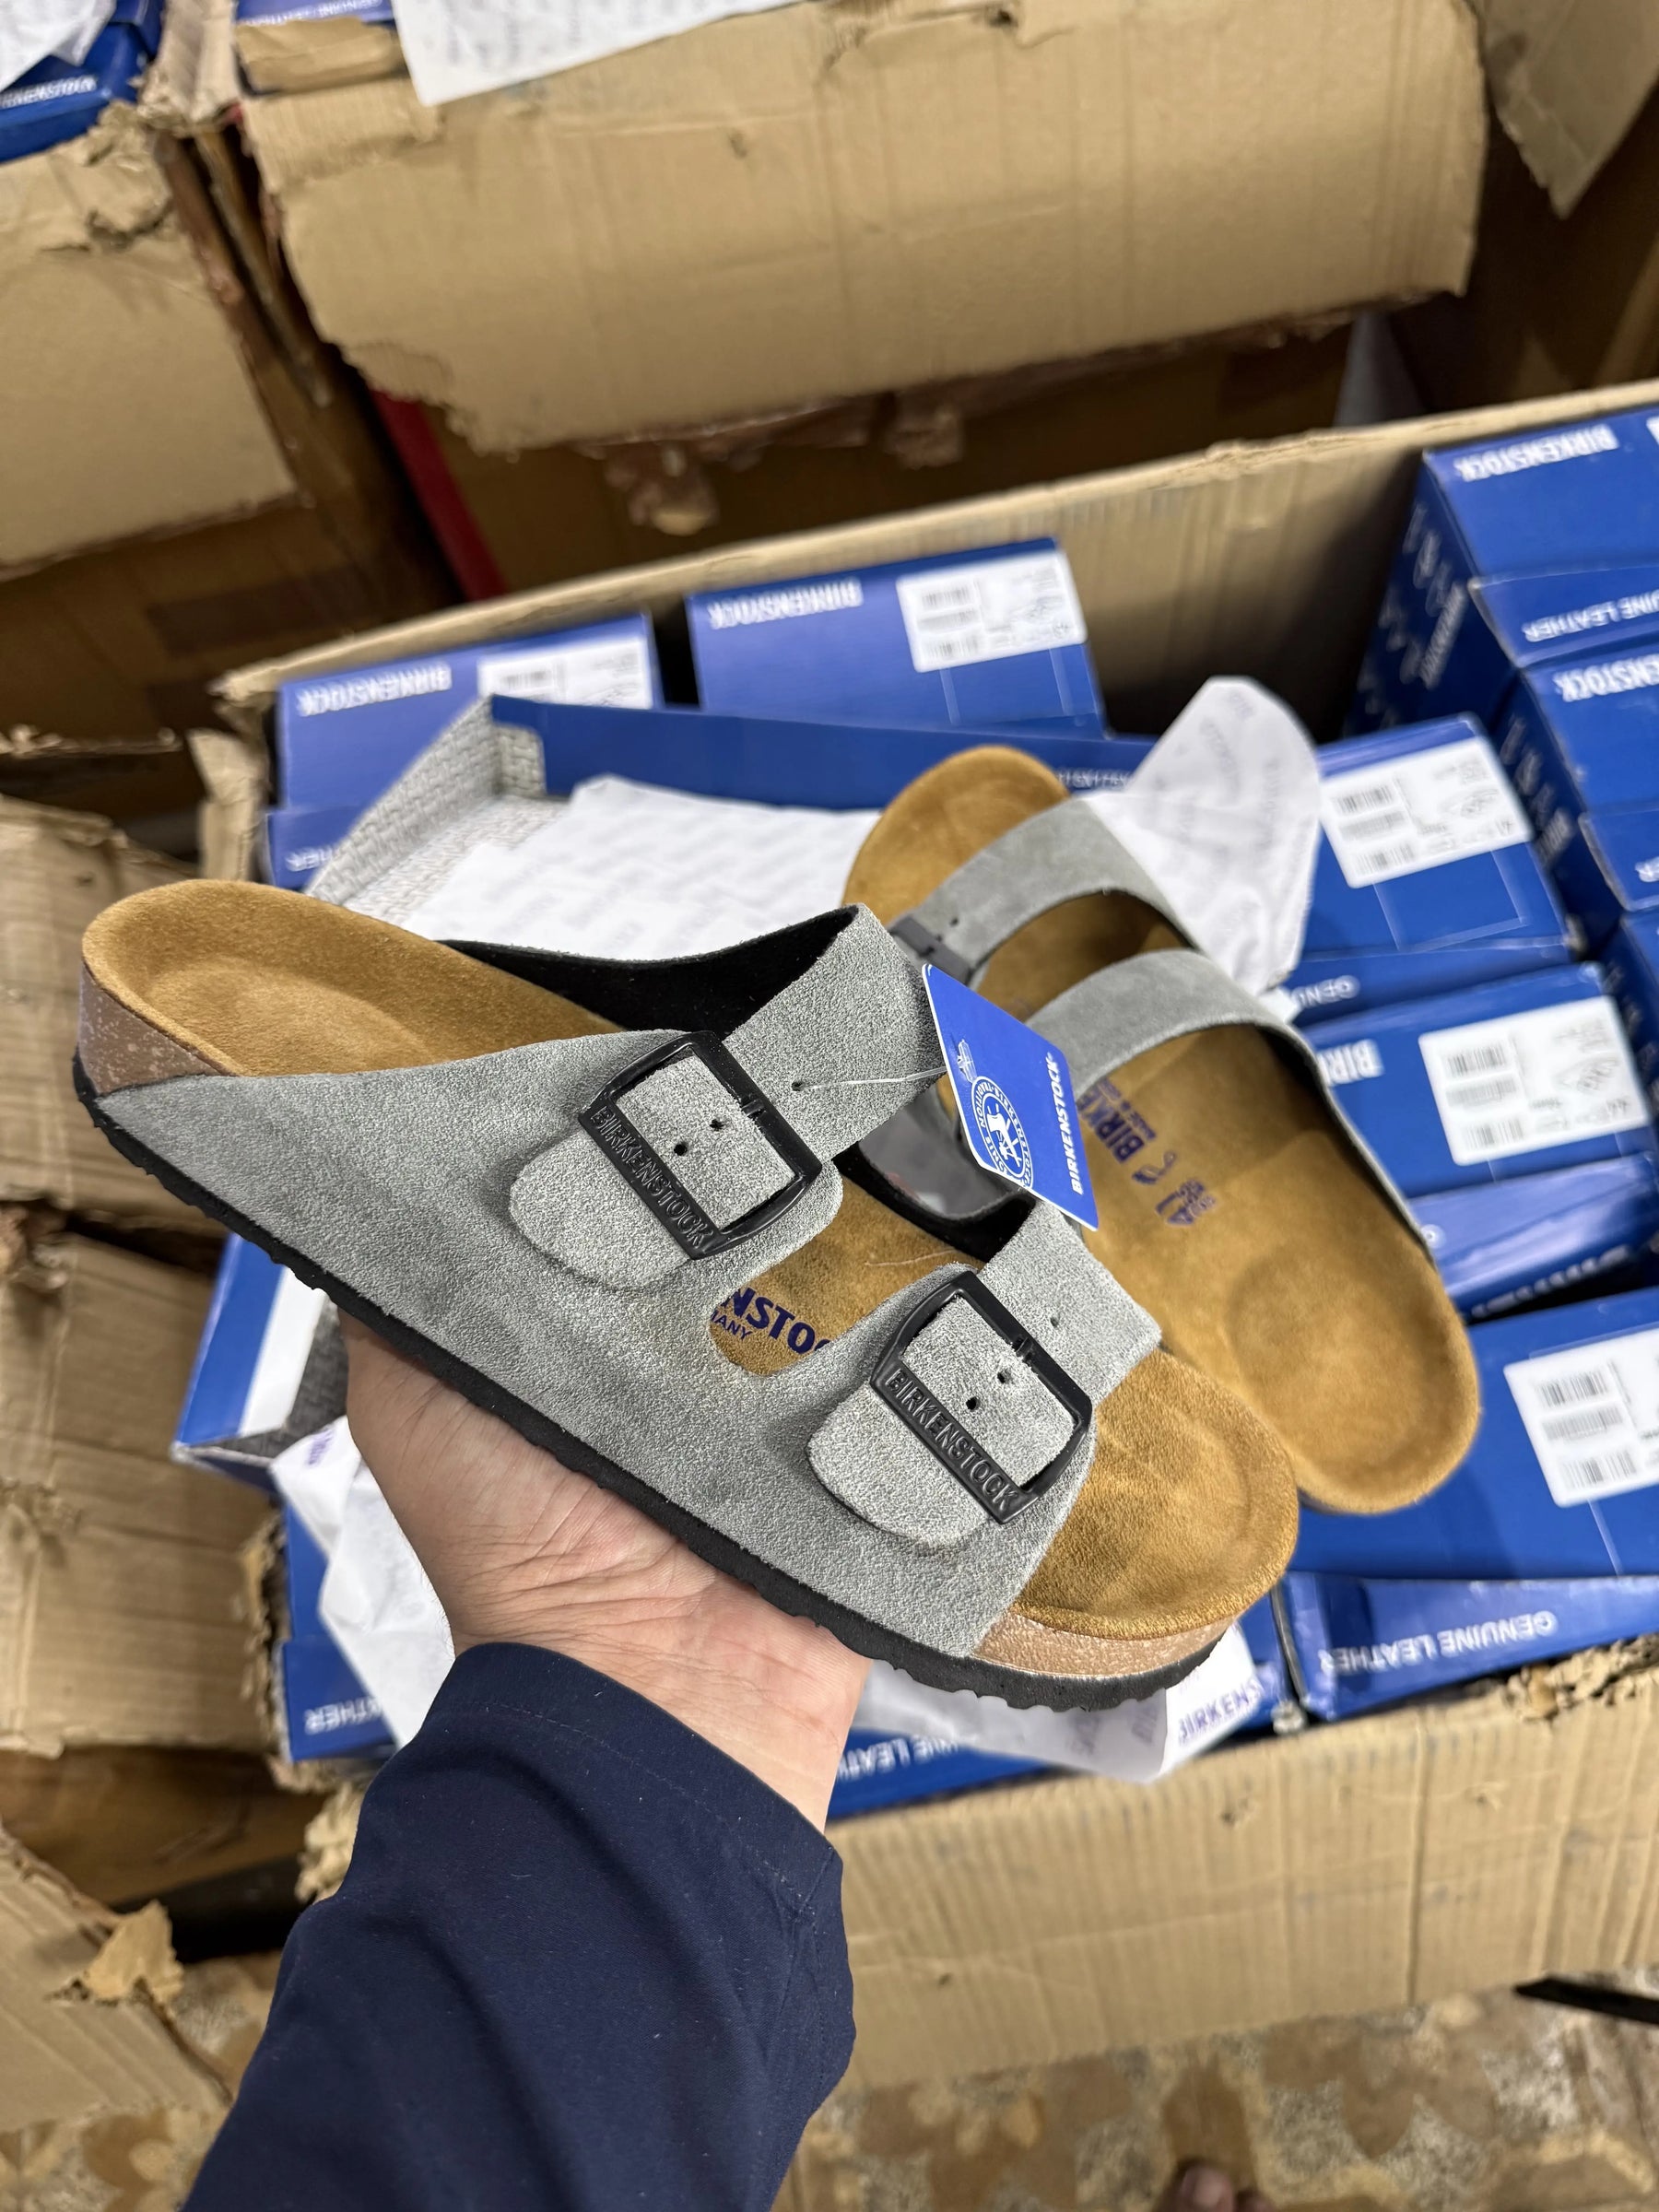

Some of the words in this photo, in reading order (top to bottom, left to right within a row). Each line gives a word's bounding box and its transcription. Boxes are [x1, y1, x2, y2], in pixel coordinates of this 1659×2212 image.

[1453, 424, 1619, 481] BIRKENSTOCK
[708, 577, 864, 630] BIRKENSTOCK
[1522, 600, 1621, 642] LEATHER
[297, 661, 452, 717] BIRKENSTOCK
[1046, 1052, 1084, 1195] BIRKENSTOCK
[590, 1106, 715, 1246] BIRKENSTOCK
[886, 1368, 1019, 1510] BIRKENSTOCK
[1318, 1634, 1439, 1677] LEATHER
[1437, 1610, 1559, 1656] GENUINE
